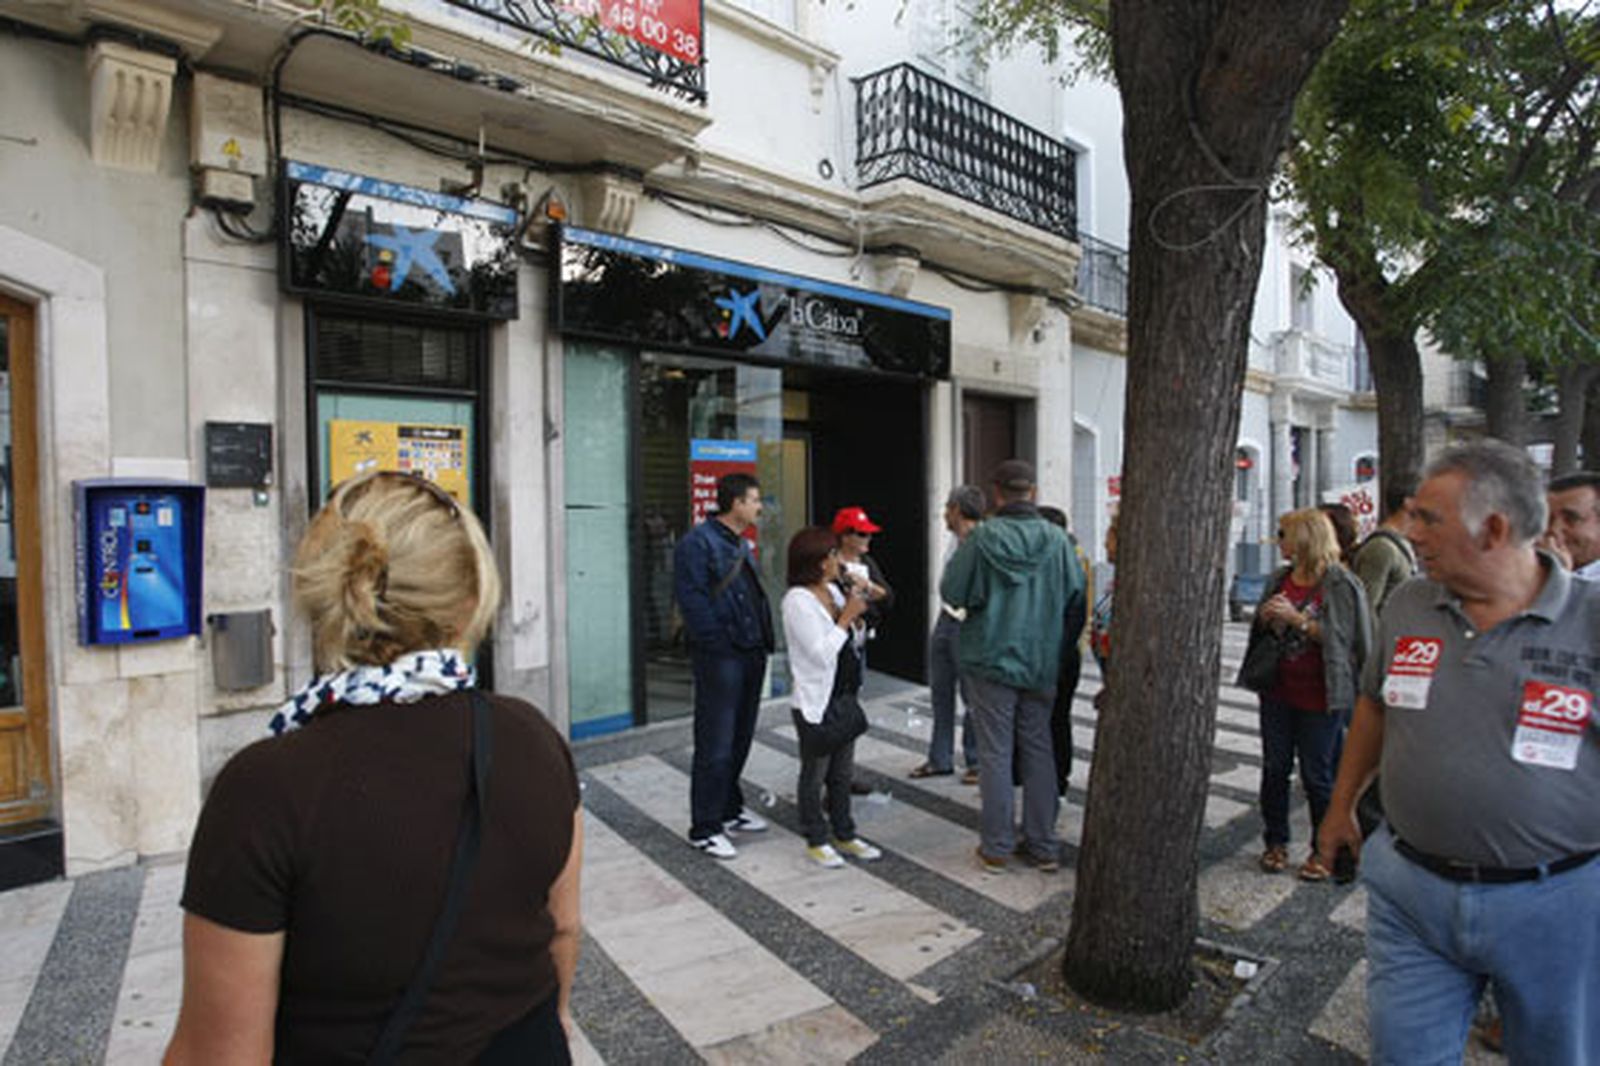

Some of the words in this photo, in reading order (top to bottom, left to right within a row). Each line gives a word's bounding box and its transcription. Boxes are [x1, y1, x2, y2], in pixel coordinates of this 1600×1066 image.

[608, 4, 635, 30] 48
[641, 15, 667, 44] 00
[673, 28, 698, 58] 38
[1408, 641, 1439, 664] 29
[1543, 689, 1587, 720] 29
